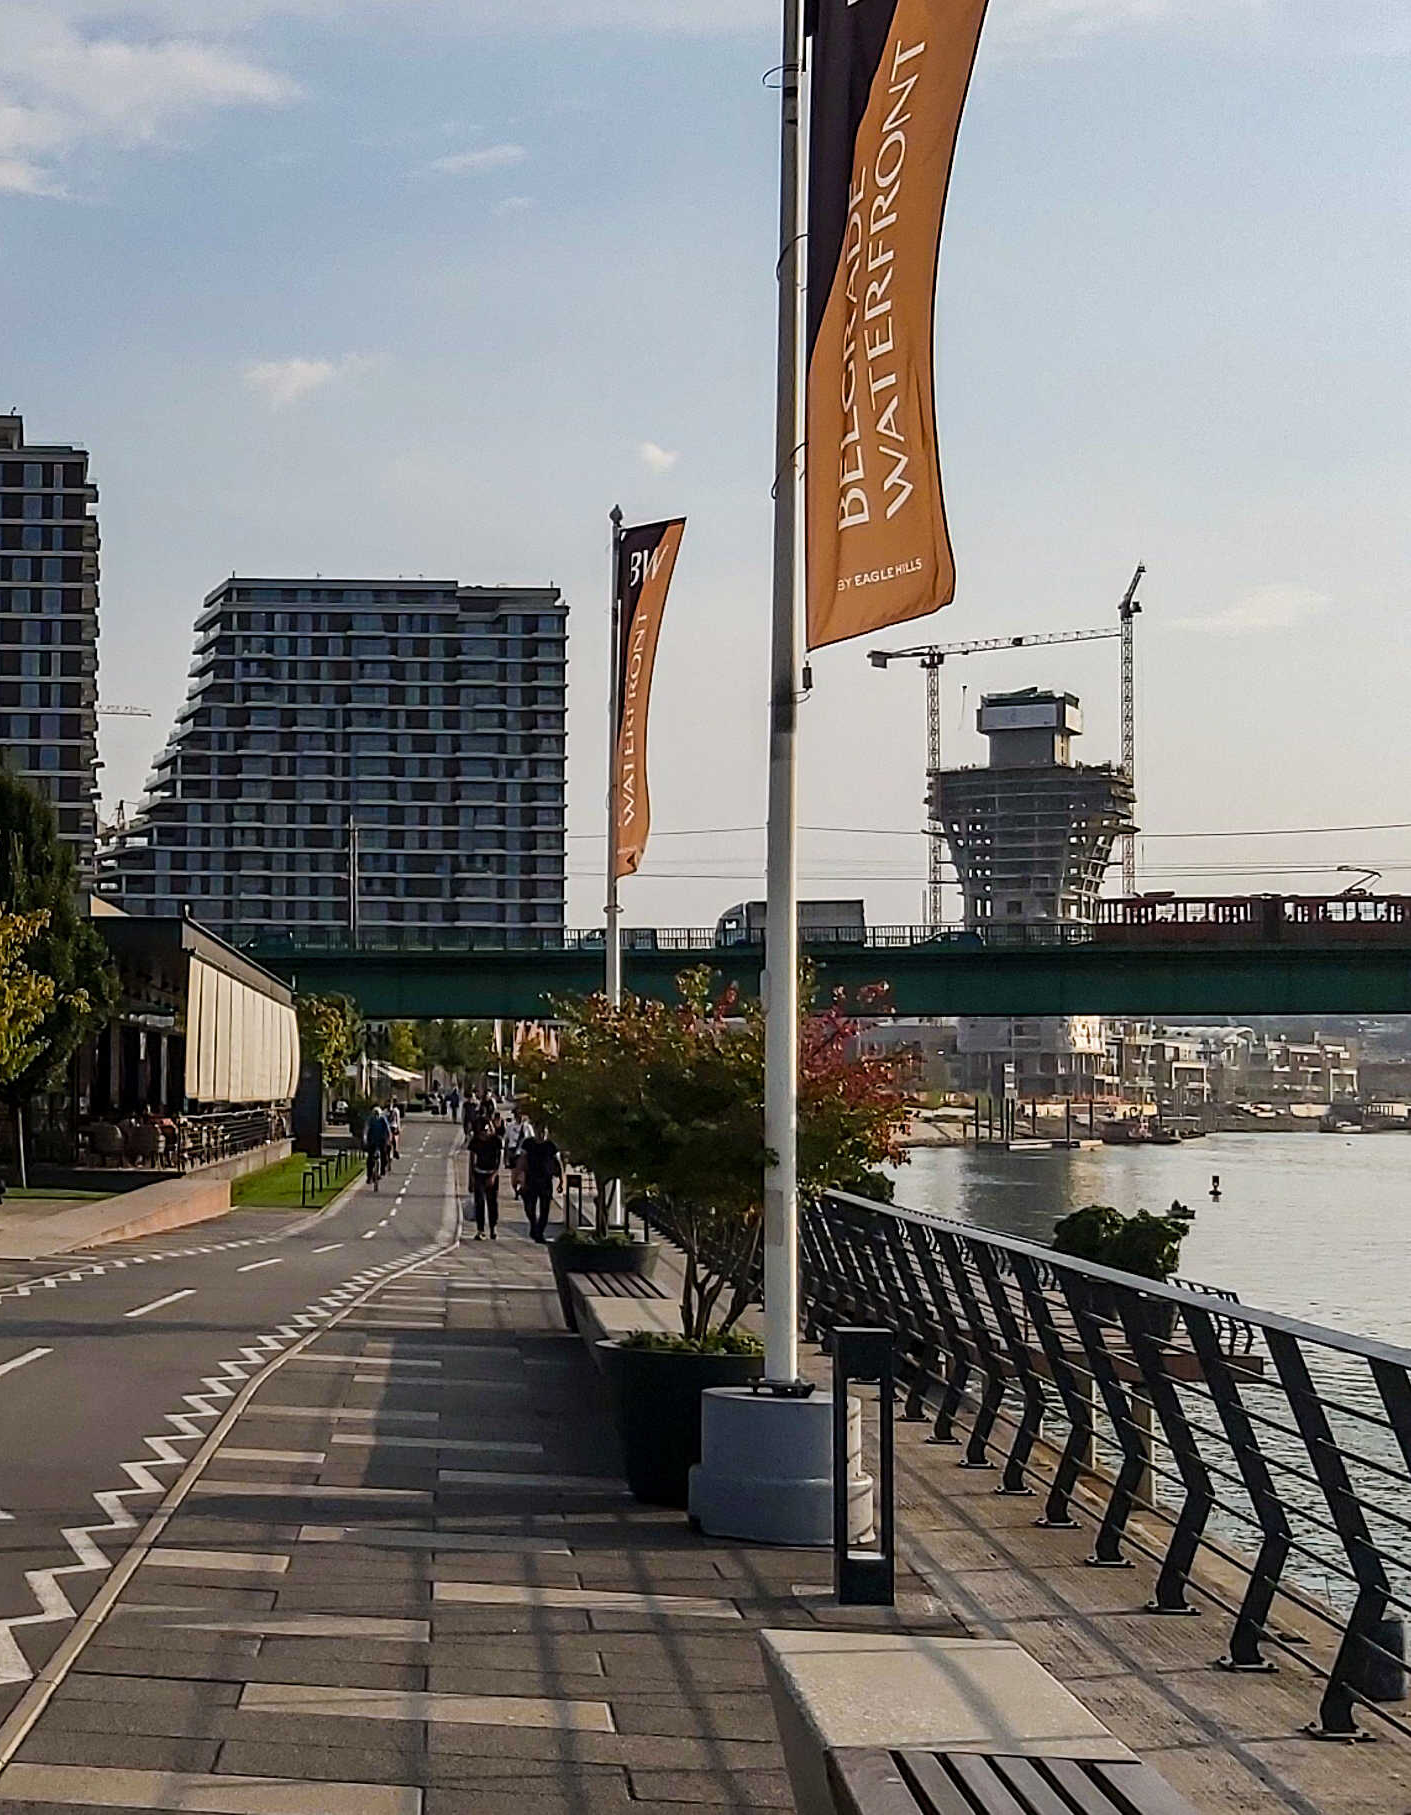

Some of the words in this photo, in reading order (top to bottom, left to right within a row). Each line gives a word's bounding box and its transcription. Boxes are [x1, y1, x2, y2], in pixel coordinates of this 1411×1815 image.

[837, 165, 870, 531] BELGRADE
[863, 39, 926, 520] WATERFRONT
[837, 579, 851, 591] BY
